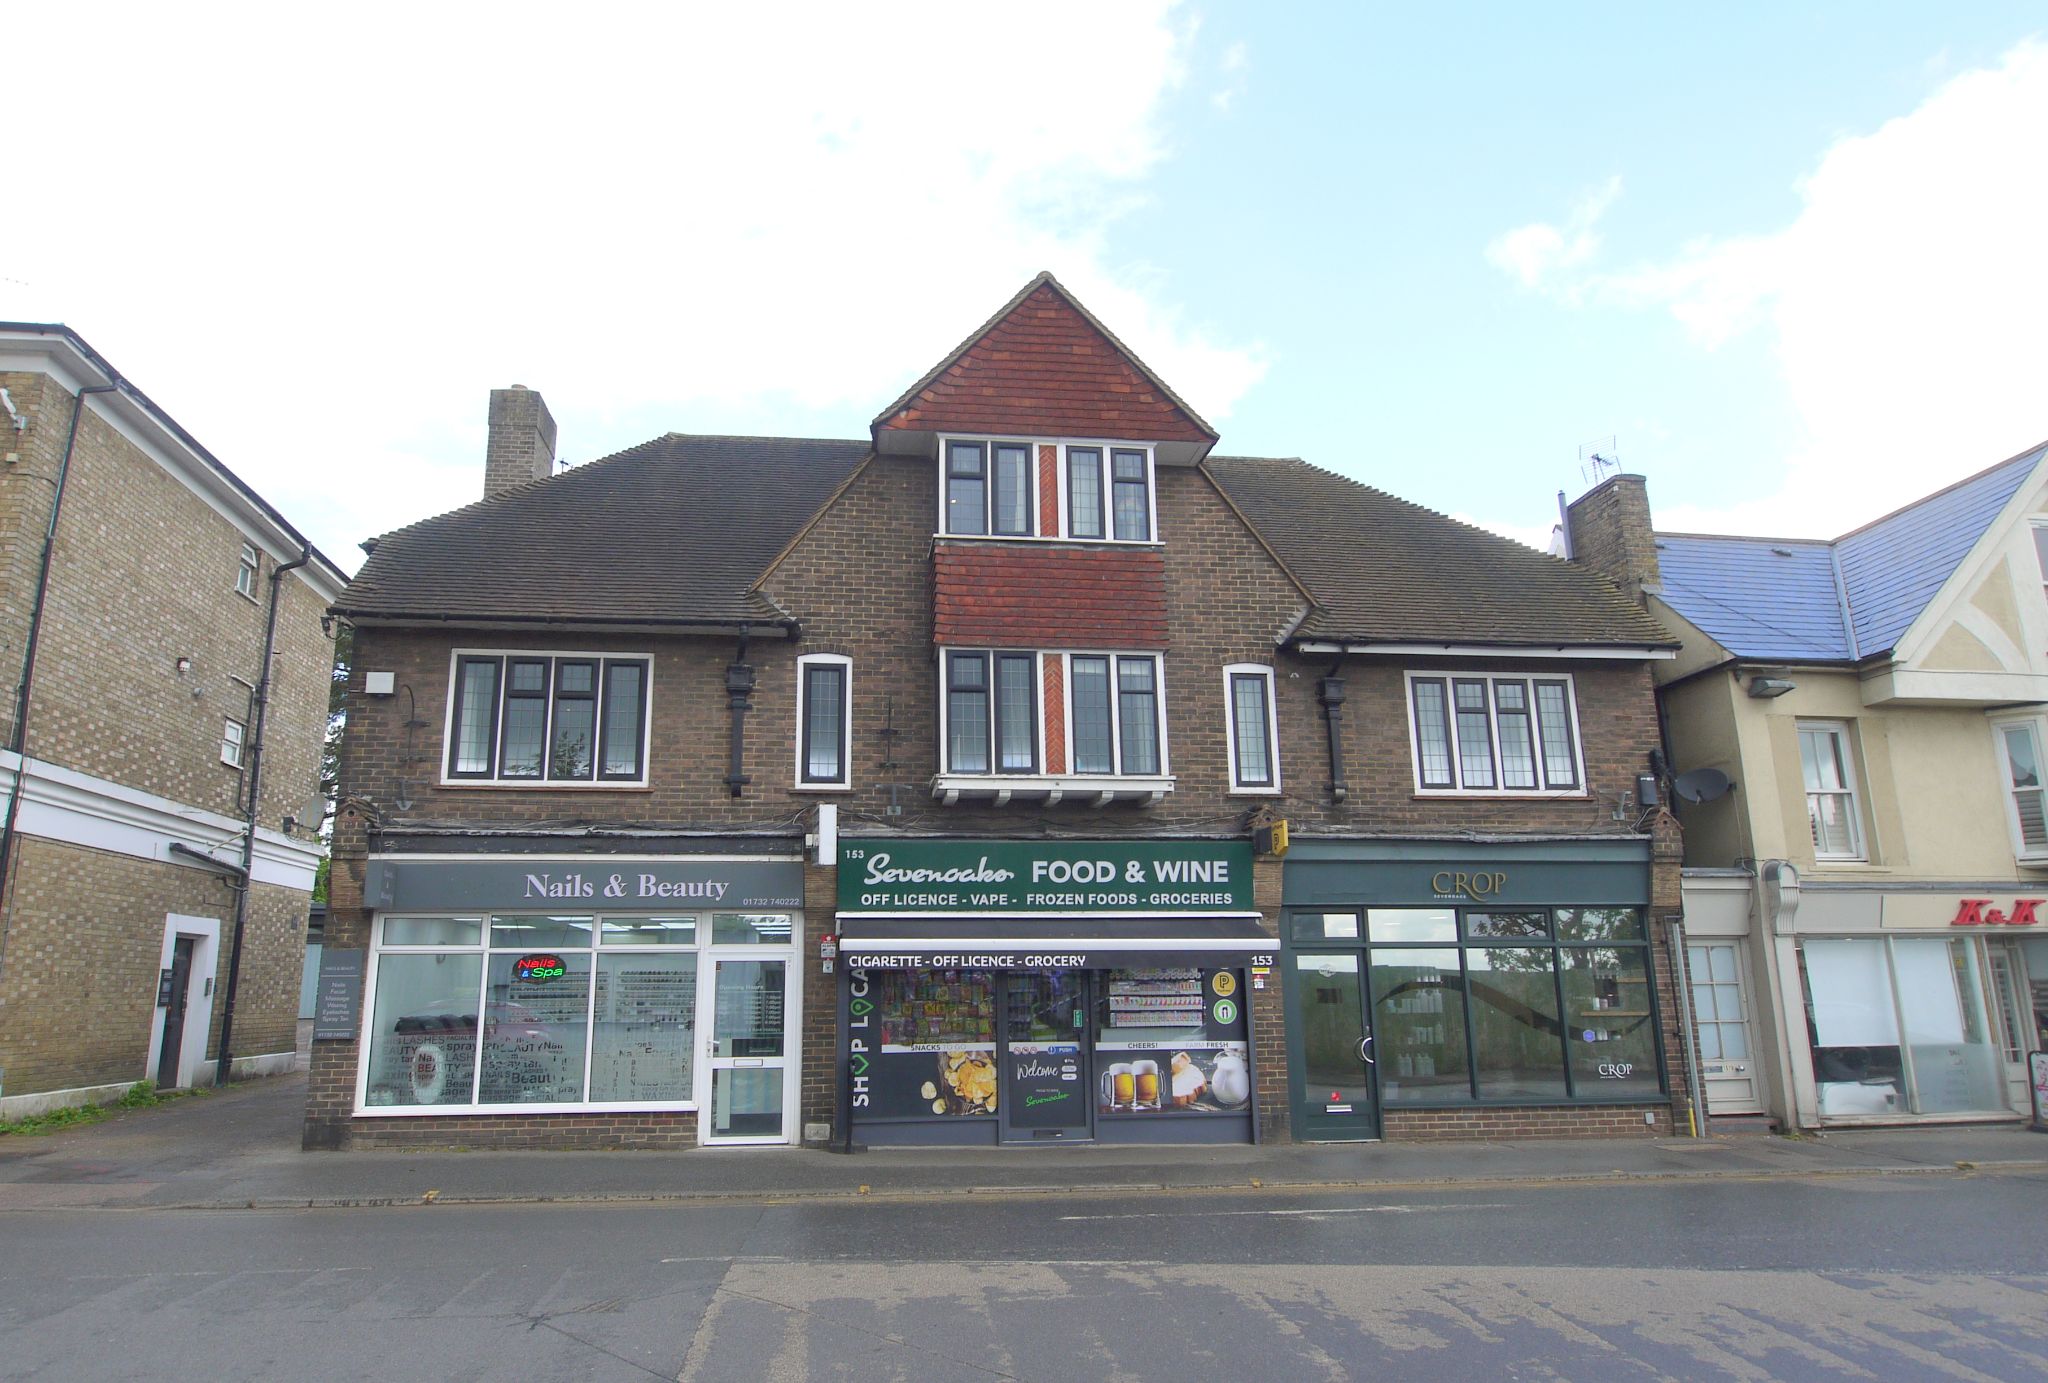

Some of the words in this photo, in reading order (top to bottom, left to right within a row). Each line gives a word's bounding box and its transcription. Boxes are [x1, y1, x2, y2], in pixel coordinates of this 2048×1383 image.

[846, 850, 865, 858] 153
[864, 853, 1014, 885] Sevenoaks
[1032, 860, 1116, 883] FOOD
[1125, 860, 1146, 883] &
[1153, 861, 1229, 883] WINE
[524, 874, 594, 898] Nails
[603, 874, 627, 898] &
[637, 874, 730, 901] Beauty
[1433, 872, 1507, 902] CROP
[743, 898, 768, 906] 01732
[770, 898, 800, 906] 740222
[861, 894, 890, 906] OFF
[894, 894, 957, 906] LICENCE
[971, 894, 1008, 906] VAPE
[1027, 894, 1084, 905] FROZEN
[1088, 893, 1138, 905] FOODS
[1150, 893, 1233, 905] GROCERIES
[518, 959, 556, 968] Nails
[849, 955, 923, 968] CIGARETTE
[932, 955, 959, 967] OFF
[961, 955, 1014, 967] LICENCE
[1025, 955, 1086, 967] GROCERY
[1251, 955, 1273, 966] 153
[531, 967, 563, 978] Spa
[851, 968, 874, 1028] LOCA
[1017, 1059, 1059, 1081] Welcome
[1598, 1063, 1633, 1079] CROP
